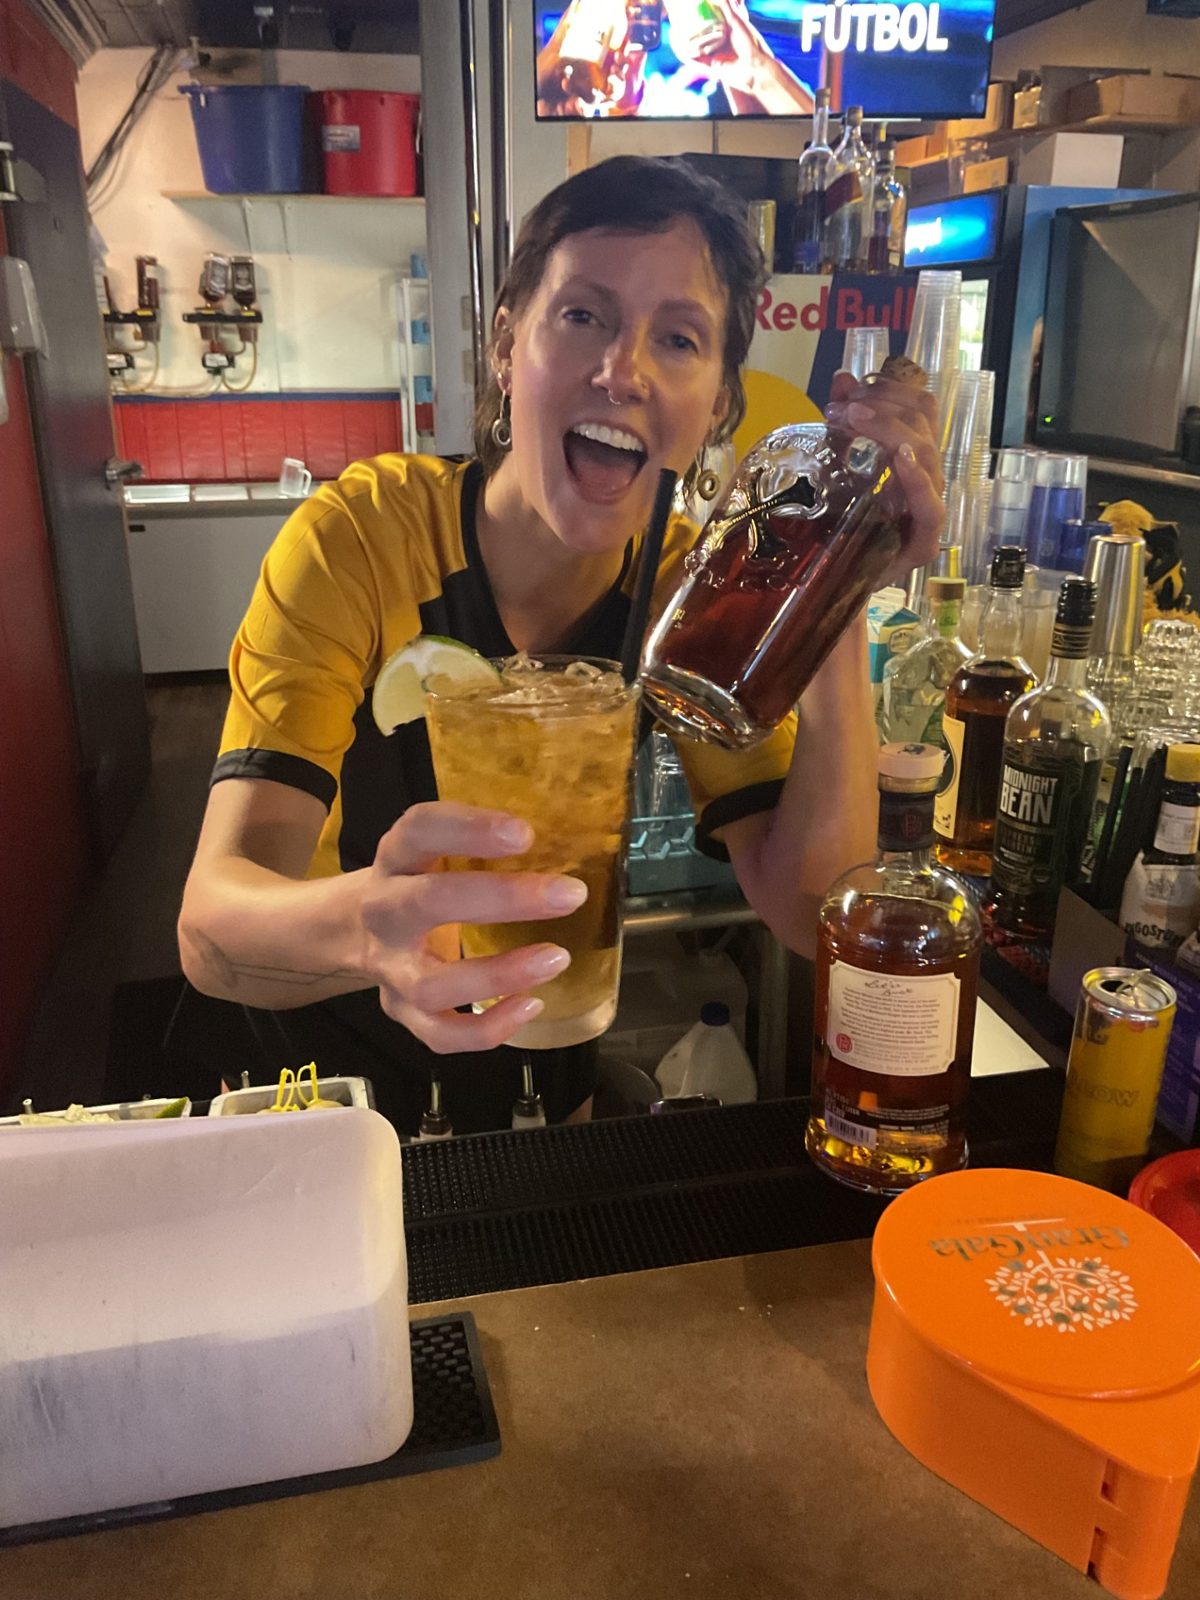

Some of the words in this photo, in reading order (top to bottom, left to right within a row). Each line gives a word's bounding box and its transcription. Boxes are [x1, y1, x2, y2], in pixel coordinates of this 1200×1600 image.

[801, 0, 949, 53] FÚTBOL
[755, 286, 830, 331] Red
[836, 286, 917, 331] Bull
[1003, 764, 1059, 796] MIDNIGHT
[1000, 781, 1053, 825] BEAN
